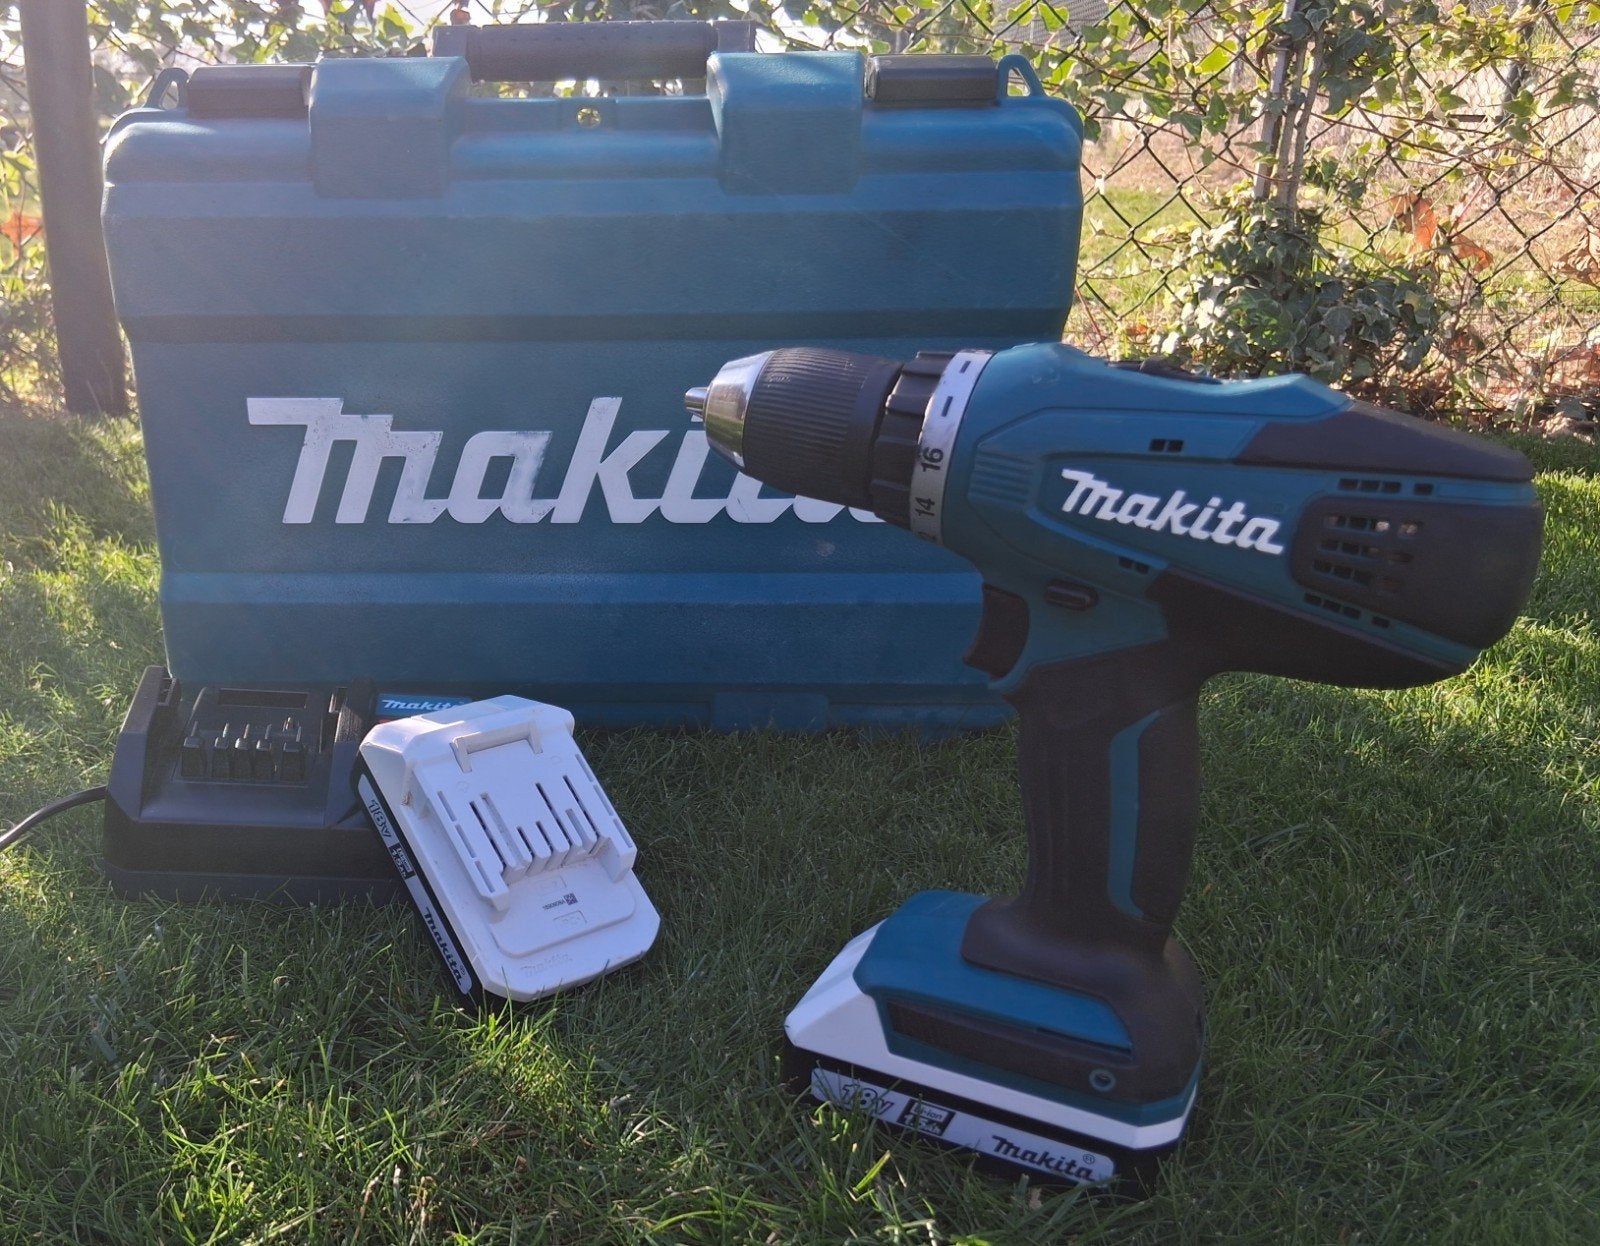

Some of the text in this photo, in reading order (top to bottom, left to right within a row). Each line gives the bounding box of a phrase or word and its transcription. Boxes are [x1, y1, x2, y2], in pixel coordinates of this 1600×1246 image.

[921, 447, 944, 472] 16
[915, 496, 936, 517] 14
[1061, 468, 1284, 555] Makita
